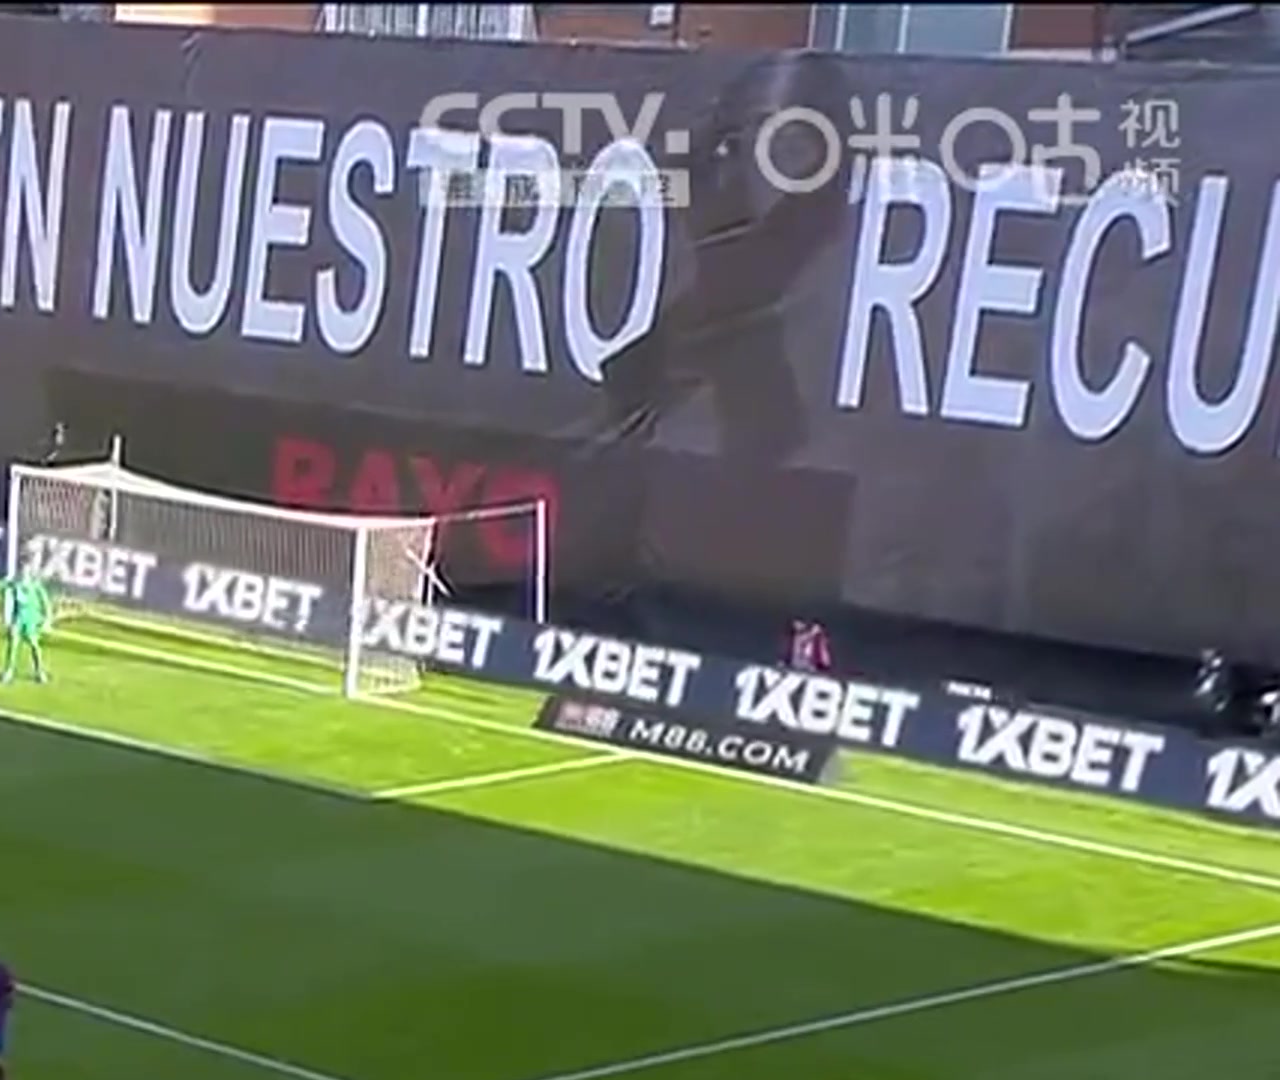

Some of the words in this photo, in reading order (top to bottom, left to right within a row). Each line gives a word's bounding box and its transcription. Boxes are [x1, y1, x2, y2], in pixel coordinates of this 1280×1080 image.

[93, 104, 667, 382] NUESTRO
[182, 562, 323, 632] 1XBET
[533, 628, 701, 707] 1XBET
[735, 664, 919, 748] 1XBET
[957, 704, 1166, 792] 1XBET
[629, 718, 809, 773] M88.COM
